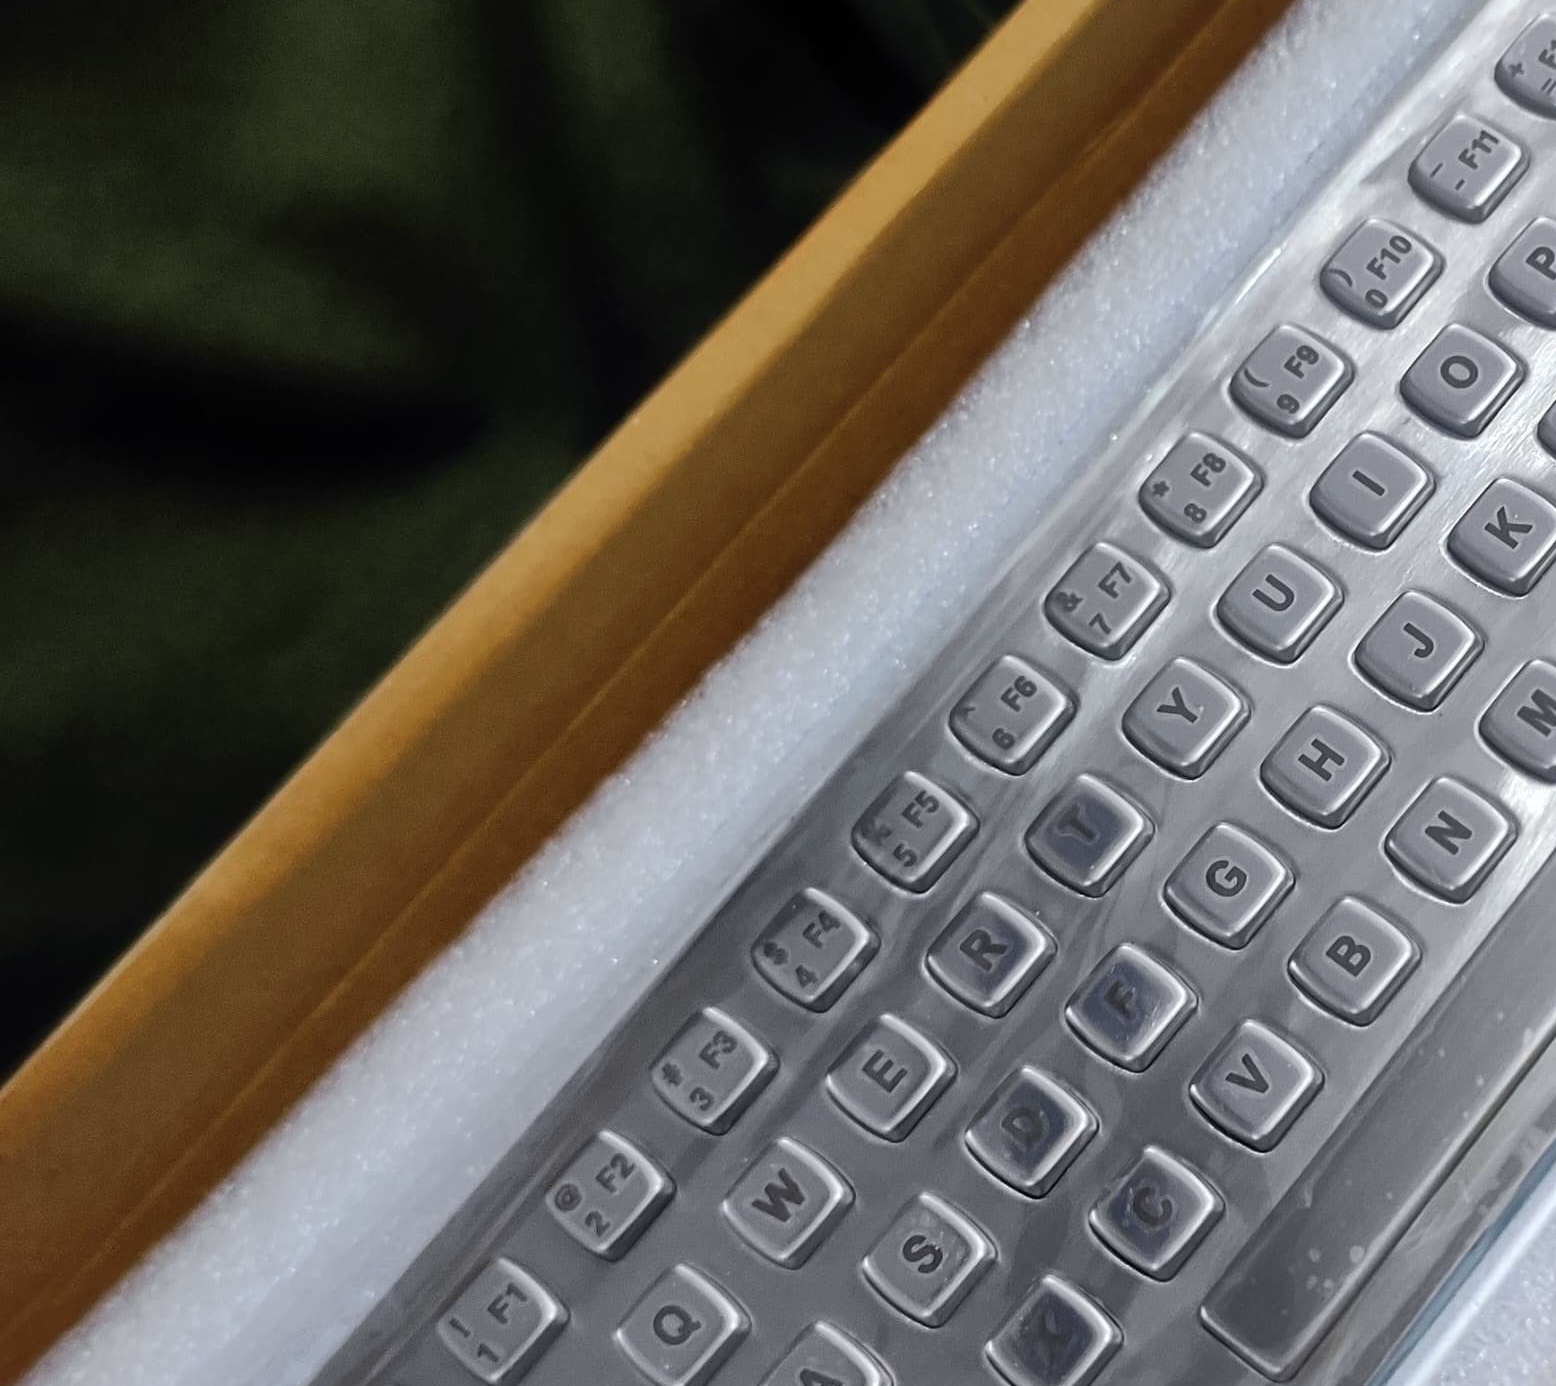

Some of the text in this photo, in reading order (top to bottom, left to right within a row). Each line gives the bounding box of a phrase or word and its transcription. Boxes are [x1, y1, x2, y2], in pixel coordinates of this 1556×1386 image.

[1459, 130, 1500, 170] F11
[1366, 235, 1413, 280] F10
[1365, 289, 1389, 309] 0
[1283, 345, 1319, 379] F9
[1440, 355, 1479, 389] O
[1276, 394, 1300, 414] 9
[1190, 453, 1226, 487] F8
[1352, 470, 1385, 497] I
[1184, 503, 1207, 523] 8
[1483, 506, 1533, 550] K
[1099, 562, 1133, 599] F7
[1252, 574, 1295, 612] U
[1054, 591, 1083, 613] &
[1088, 613, 1112, 635] 7
[1403, 623, 1435, 659] J
[1000, 676, 1038, 712] F6
[1157, 687, 1198, 724] Y
[992, 728, 1015, 750] 6
[1298, 738, 1345, 782] H
[901, 790, 939, 829] F5
[1057, 804, 1097, 840] T
[1425, 810, 1473, 855] N
[893, 843, 917, 868] 5
[1206, 859, 1247, 897] G
[801, 910, 841, 949] F4
[959, 929, 1008, 971] R
[1325, 935, 1372, 977] B
[795, 965, 818, 988] 4
[1105, 981, 1137, 1019] F
[699, 1030, 738, 1069] F3
[862, 1050, 908, 1094] E
[1225, 1053, 1269, 1094] V
[689, 1087, 714, 1111] 3
[1001, 1107, 1048, 1146] D
[596, 1153, 635, 1194] F2
[752, 1168, 805, 1222] W
[1132, 1186, 1173, 1227] C
[584, 1212, 610, 1236] 2
[902, 1234, 944, 1274] S
[487, 1282, 527, 1324] F1
[653, 1305, 702, 1345] Q
[477, 1343, 499, 1362] 1
